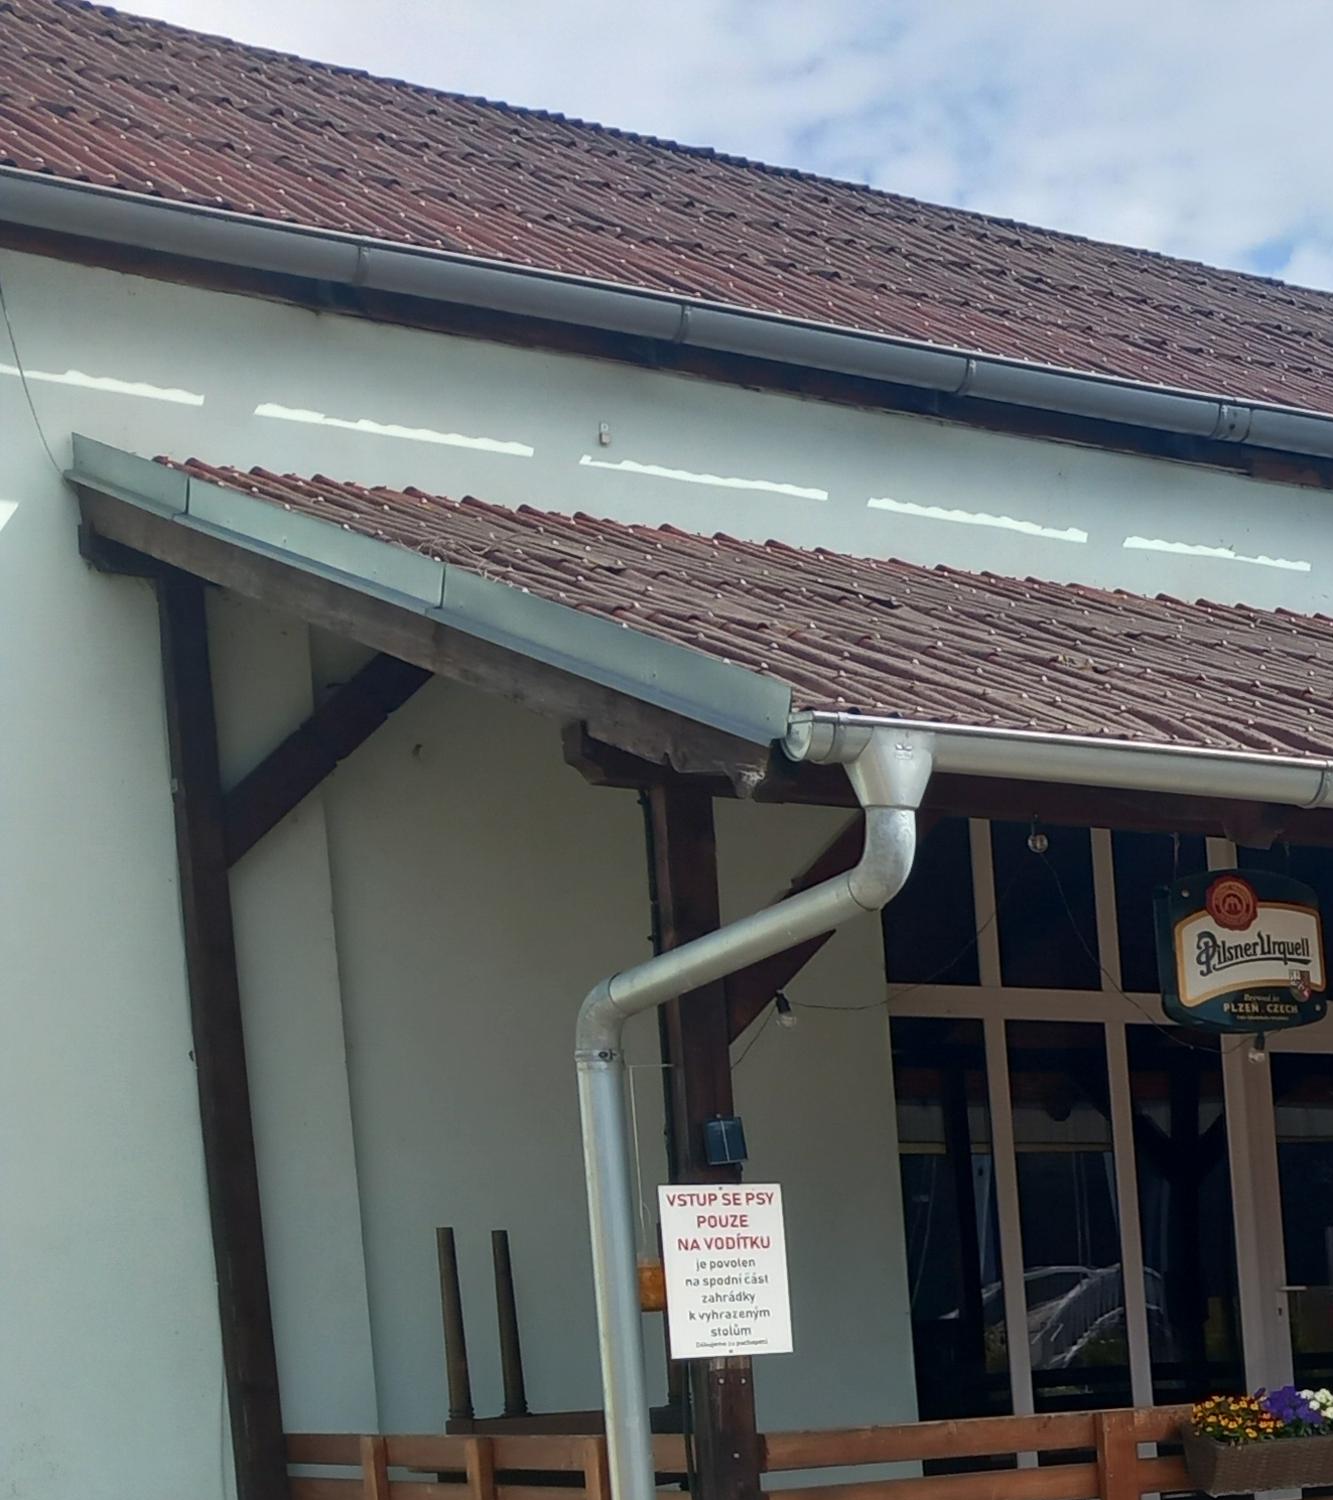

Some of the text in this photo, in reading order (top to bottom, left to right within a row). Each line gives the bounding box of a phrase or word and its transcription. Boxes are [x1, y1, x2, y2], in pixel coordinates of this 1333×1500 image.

[1196, 931, 1311, 977] Pilsner Urquell
[1266, 1003, 1298, 1013] CZECH
[666, 1192, 774, 1207] VSTUP SE PSY
[696, 1214, 749, 1228] POUZE
[677, 1233, 771, 1251] NA VODÍTKU
[695, 1257, 756, 1271] je povolen
[685, 1273, 768, 1288] na spodní část
[701, 1290, 756, 1303] zahrádky
[689, 1307, 770, 1323] k vyhrazeným
[710, 1323, 752, 1337] stolům
